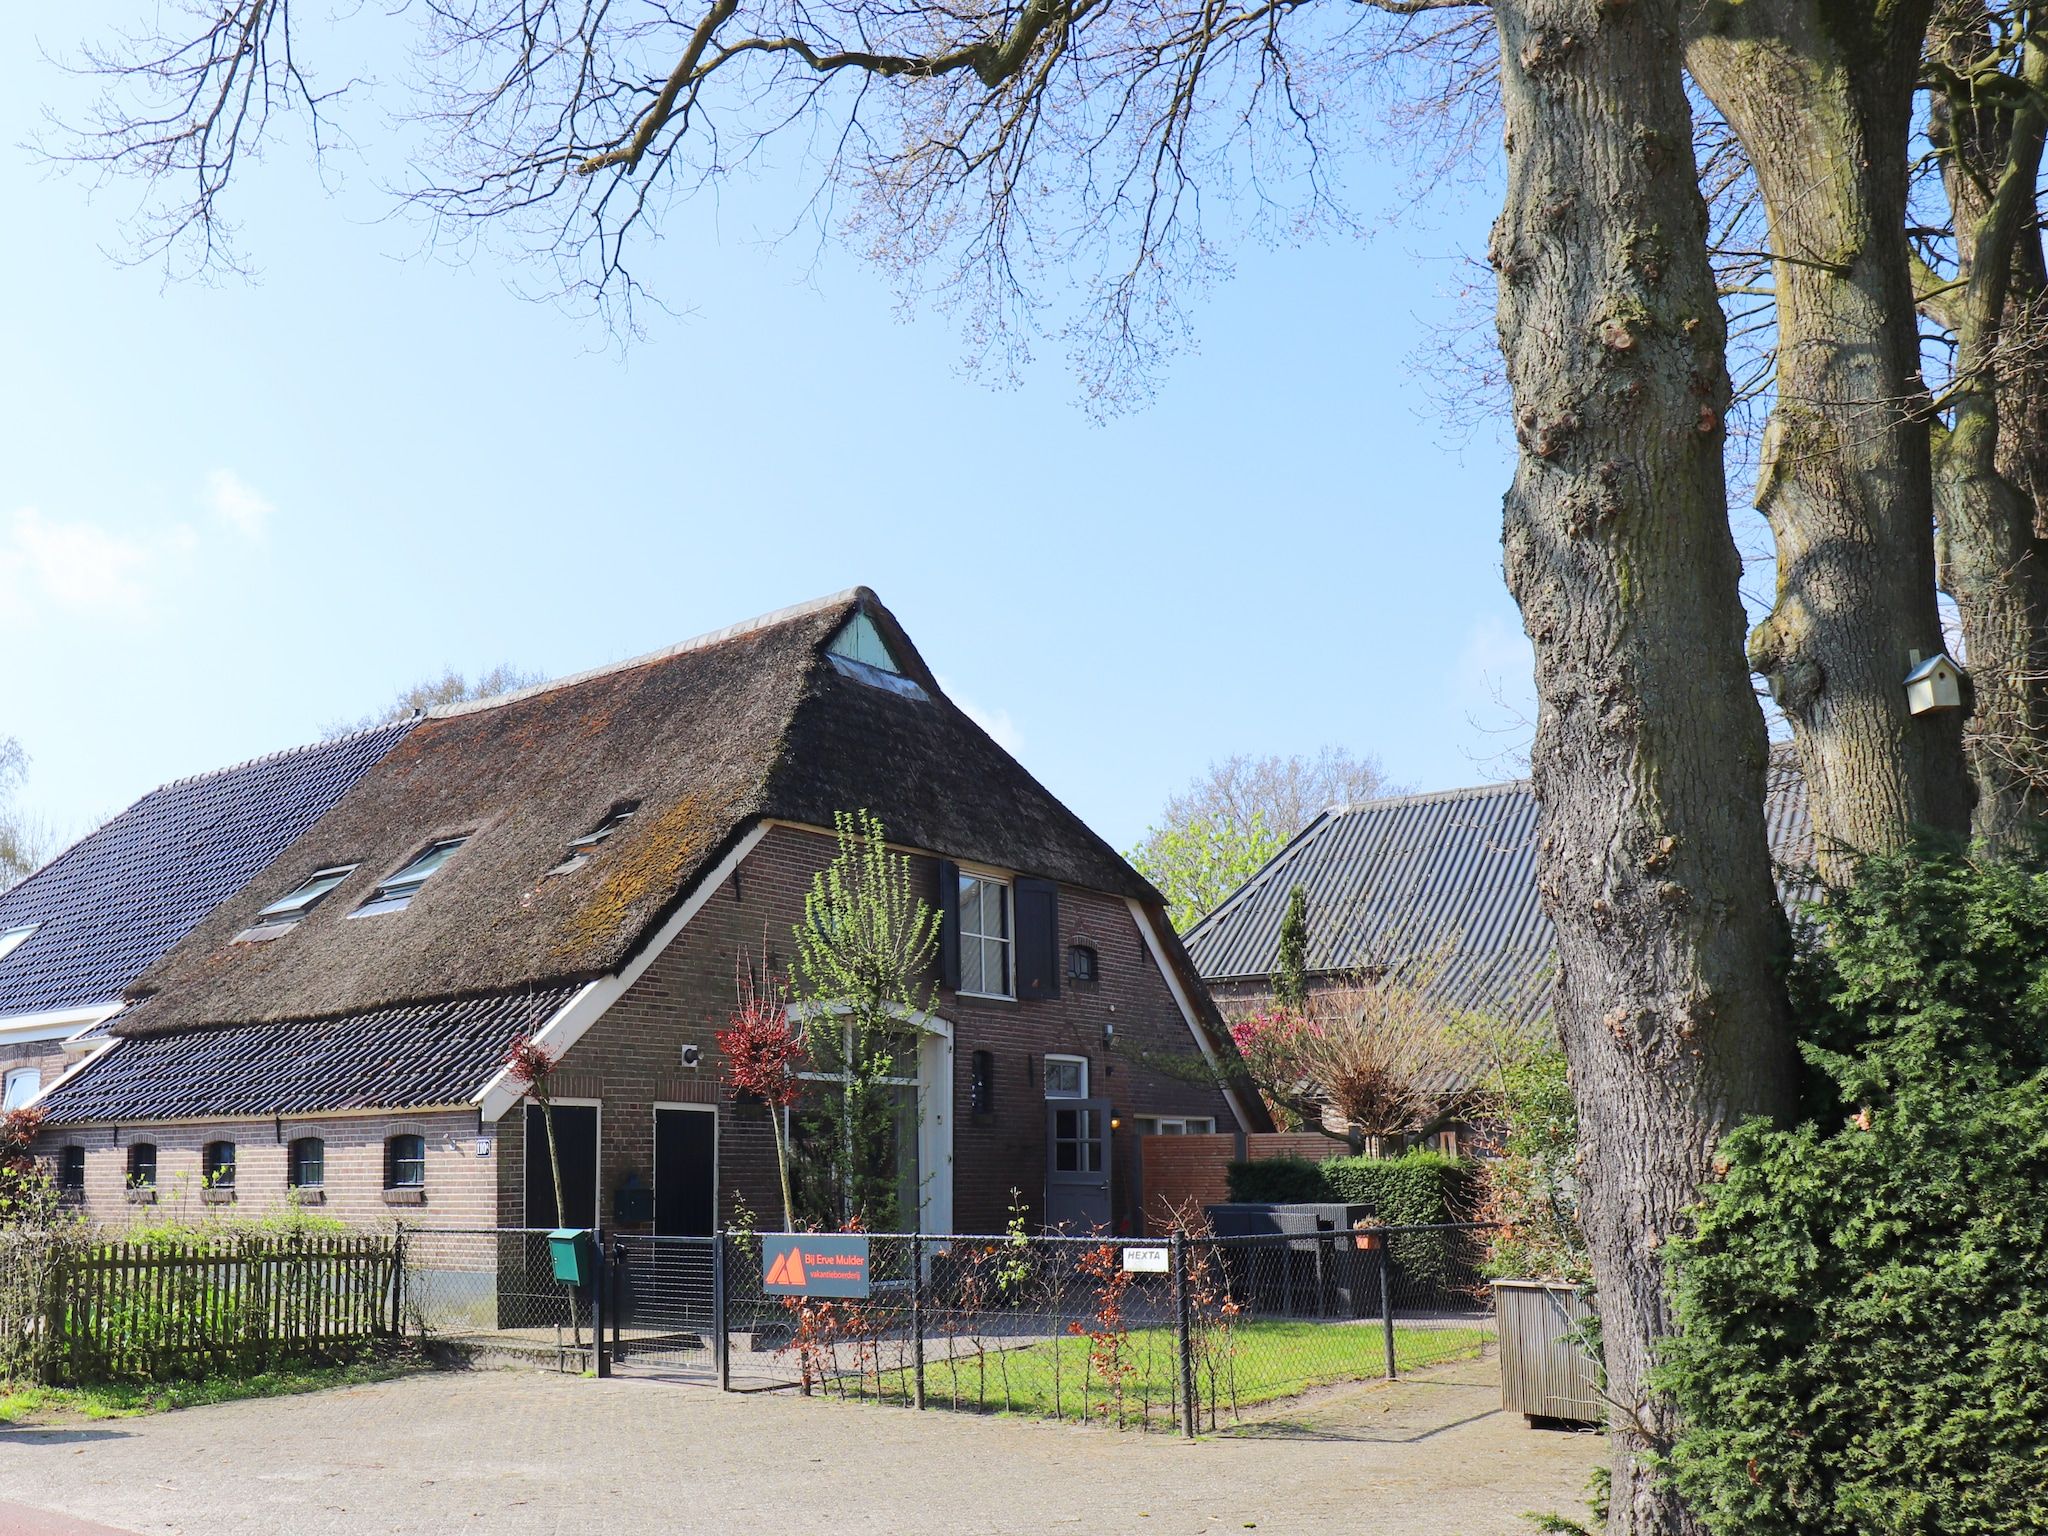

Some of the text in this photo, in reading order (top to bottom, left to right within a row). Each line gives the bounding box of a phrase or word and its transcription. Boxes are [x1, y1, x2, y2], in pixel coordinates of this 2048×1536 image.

[805, 1254, 865, 1265] Bij Erve Mulder
[1127, 1250, 1161, 1260] HEXTA
[810, 1270, 861, 1281] vakantieboerderij
